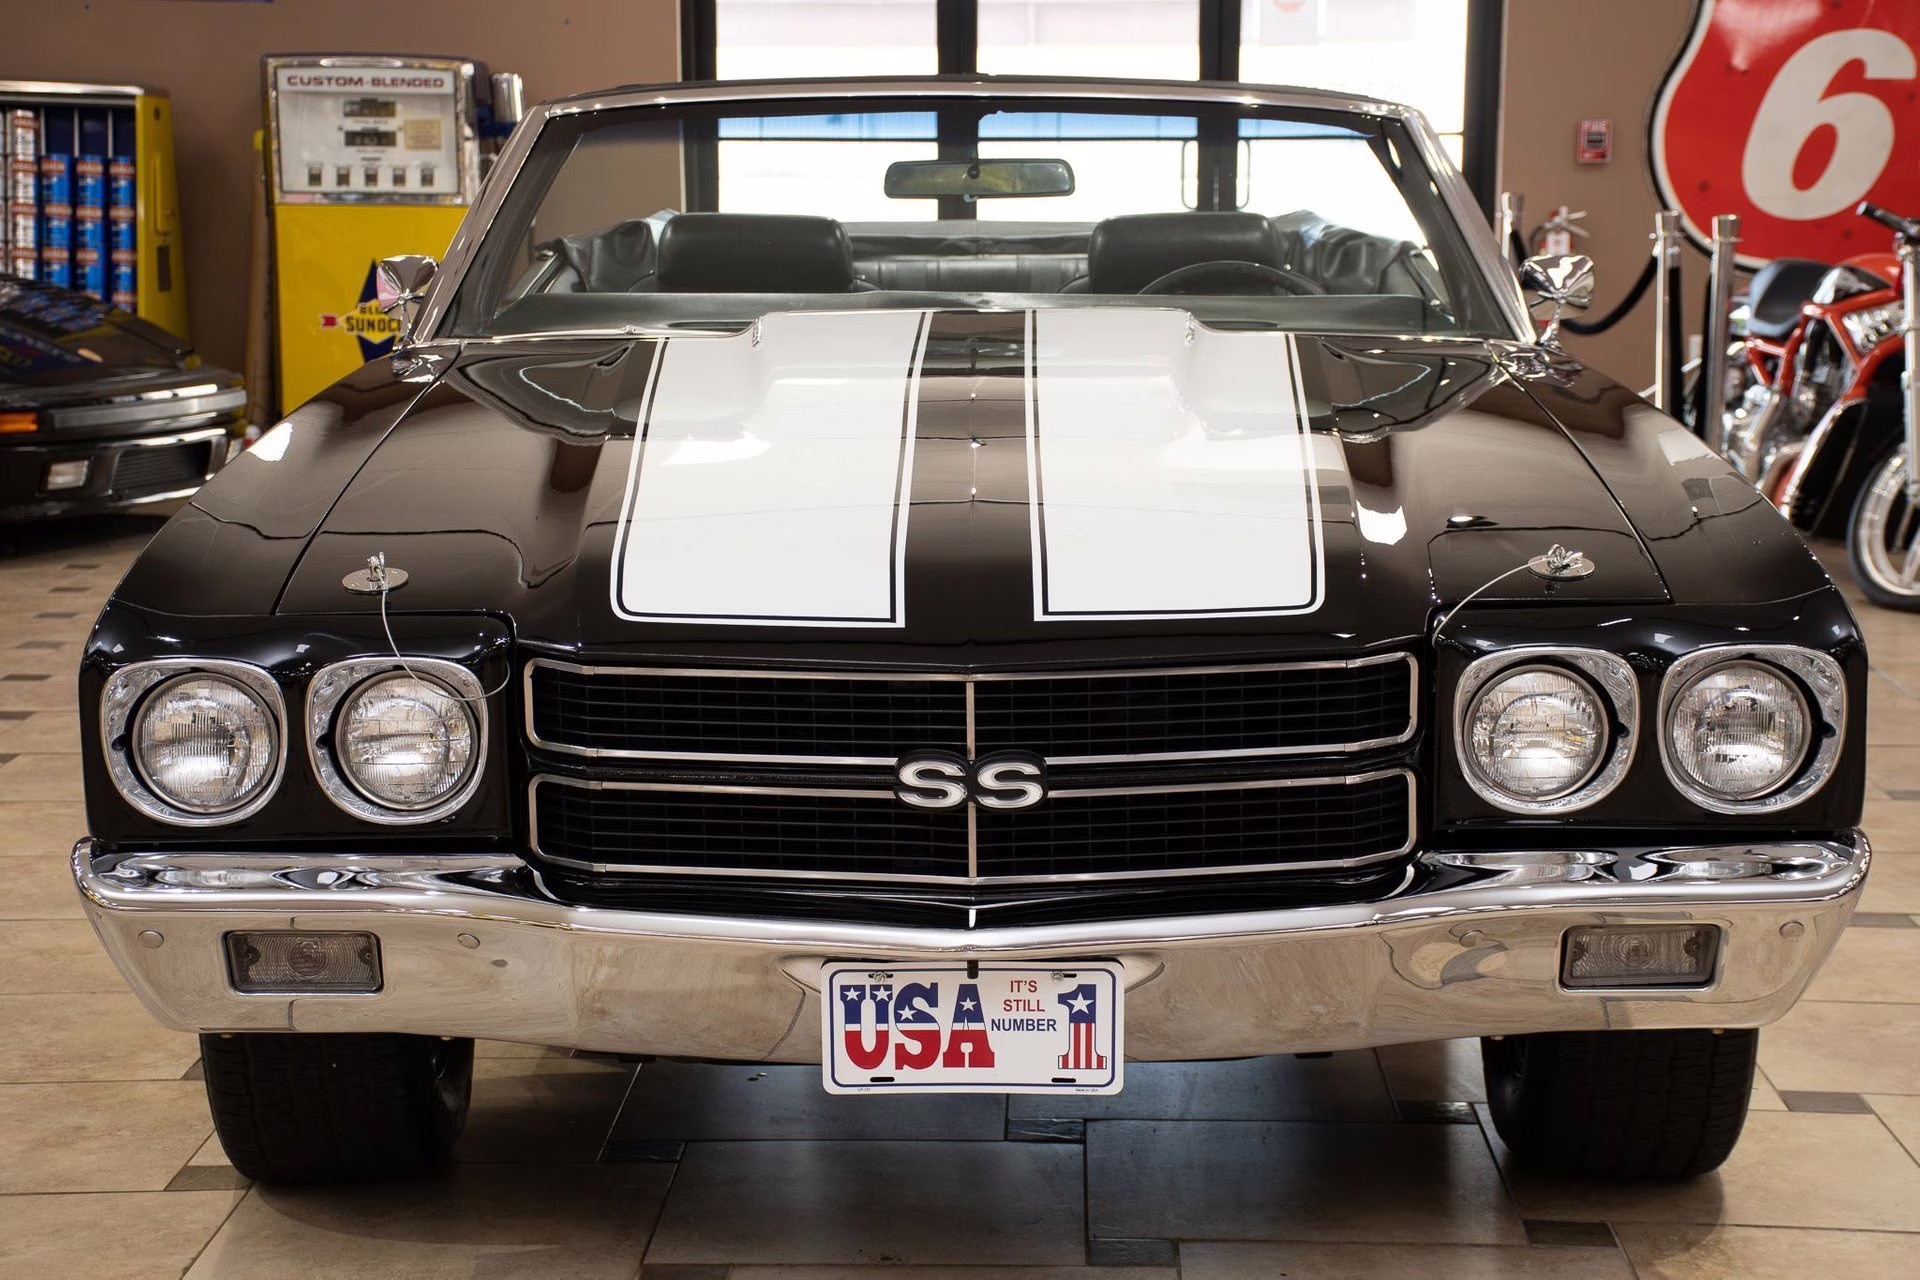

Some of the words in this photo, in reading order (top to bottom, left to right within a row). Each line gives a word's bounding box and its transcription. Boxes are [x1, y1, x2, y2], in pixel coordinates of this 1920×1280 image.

[898, 760, 1044, 809] SS
[1010, 980, 1038, 993] IT'S
[1003, 999, 1046, 1012] STILL
[840, 982, 995, 1070] USA
[991, 1018, 1057, 1031] NUMBER
[1057, 984, 1107, 1070] 1
